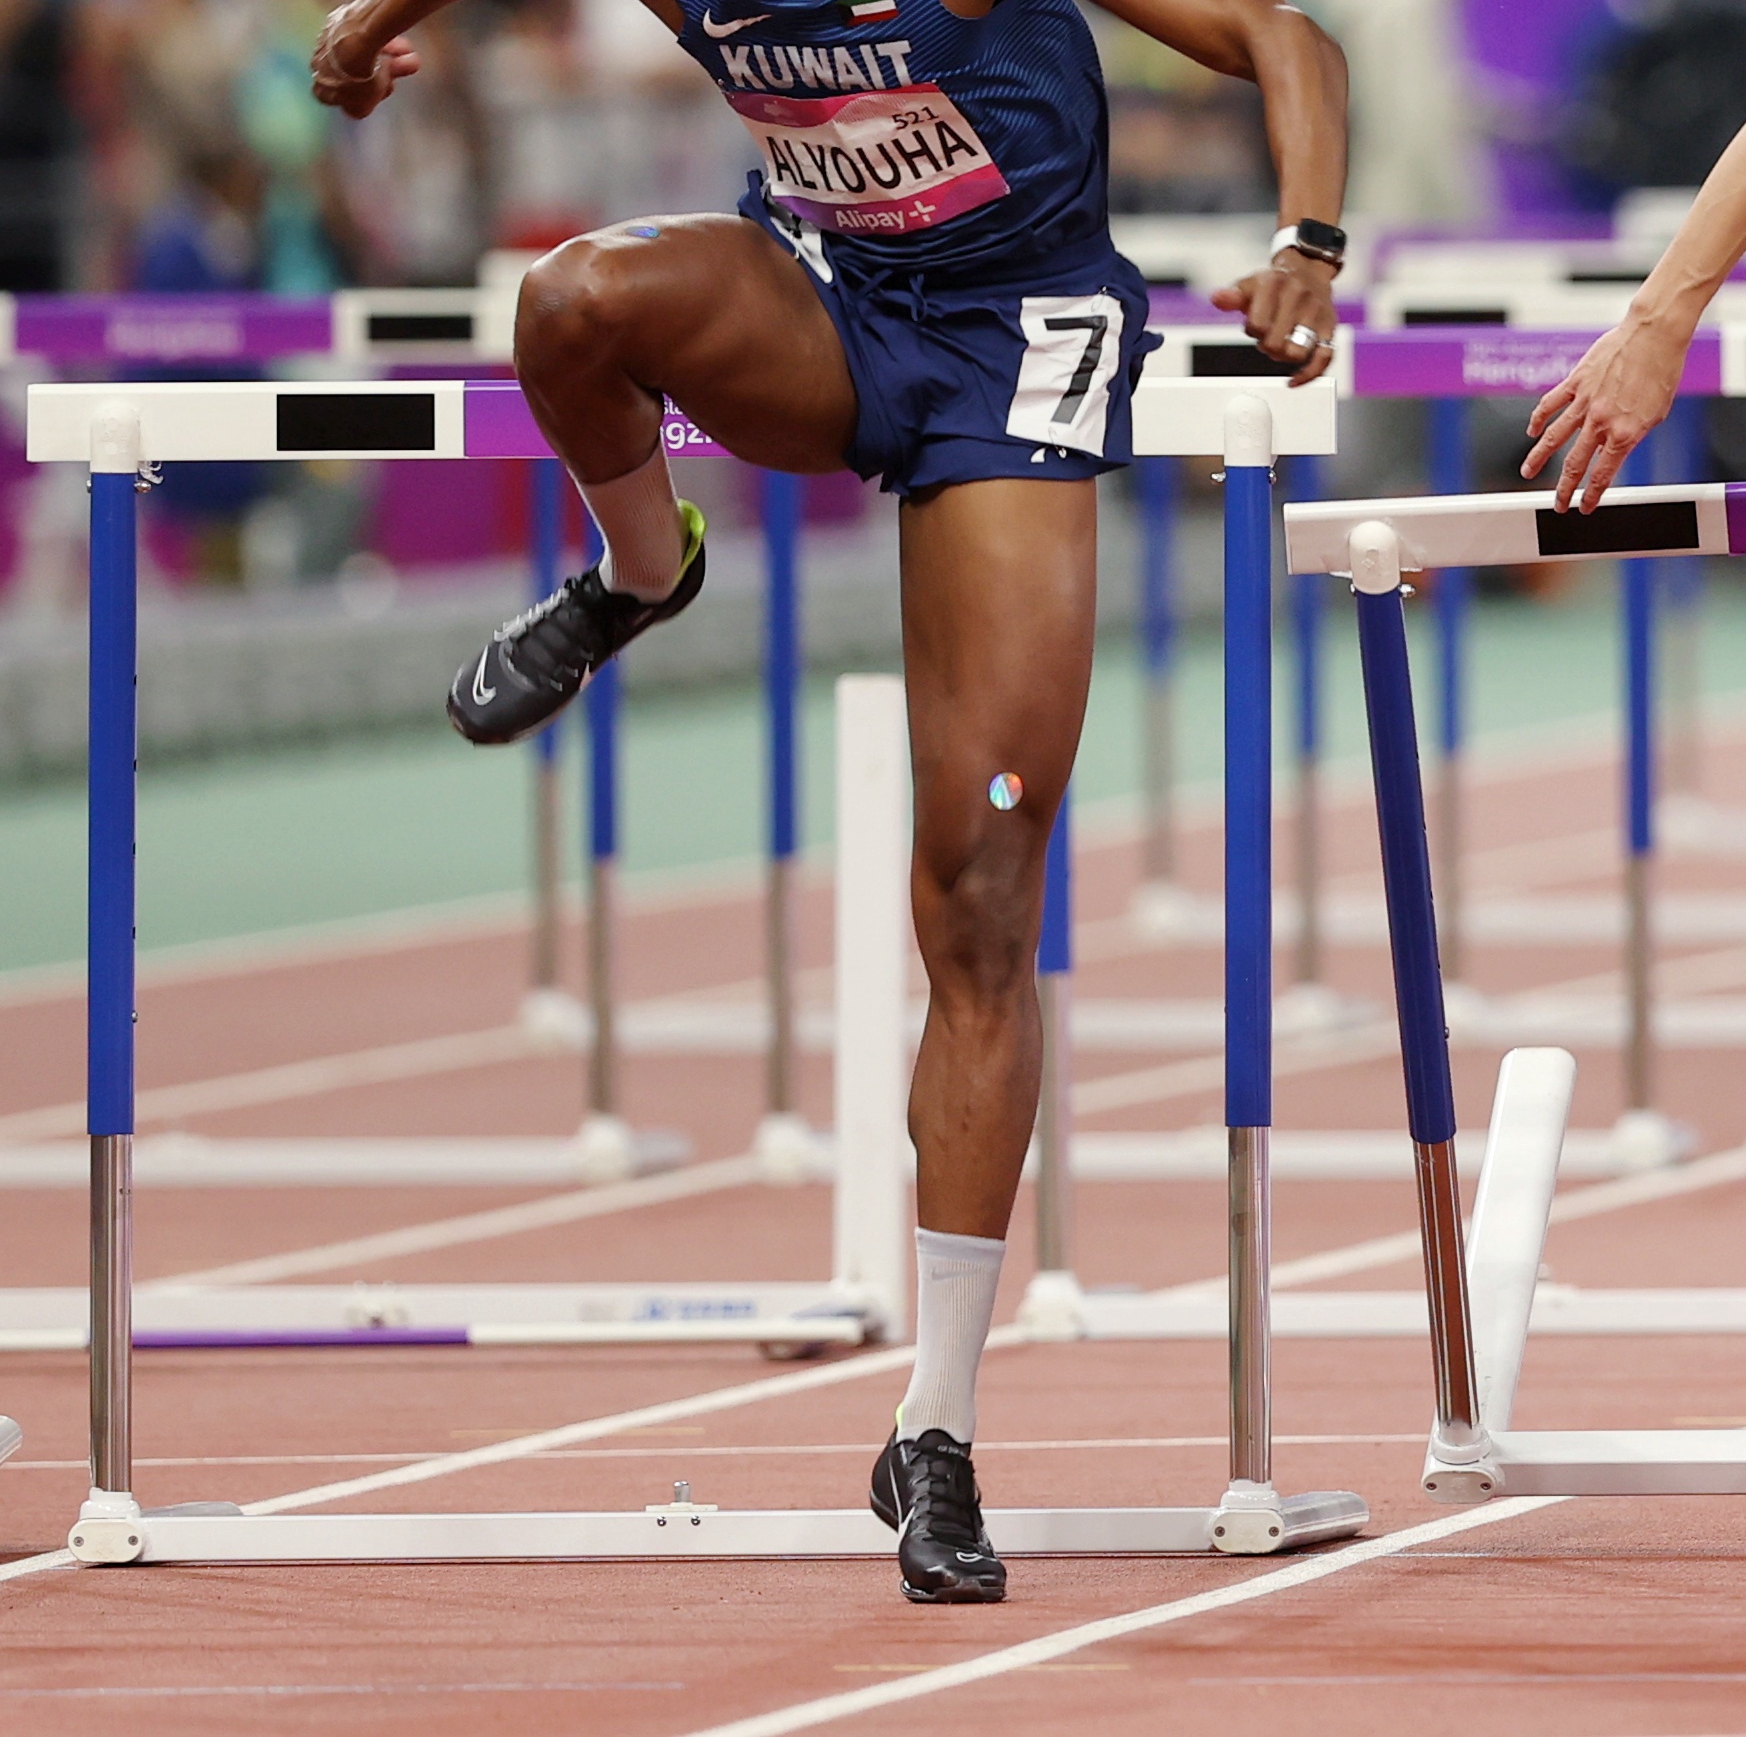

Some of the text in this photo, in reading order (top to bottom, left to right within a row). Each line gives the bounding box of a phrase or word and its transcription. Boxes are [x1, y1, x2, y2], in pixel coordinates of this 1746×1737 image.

[719, 39, 913, 90] KUWAIT
[892, 106, 939, 131] 521
[766, 120, 979, 194] ALYOUHA
[836, 205, 906, 231] Alipay
[1044, 314, 1109, 424] 7
